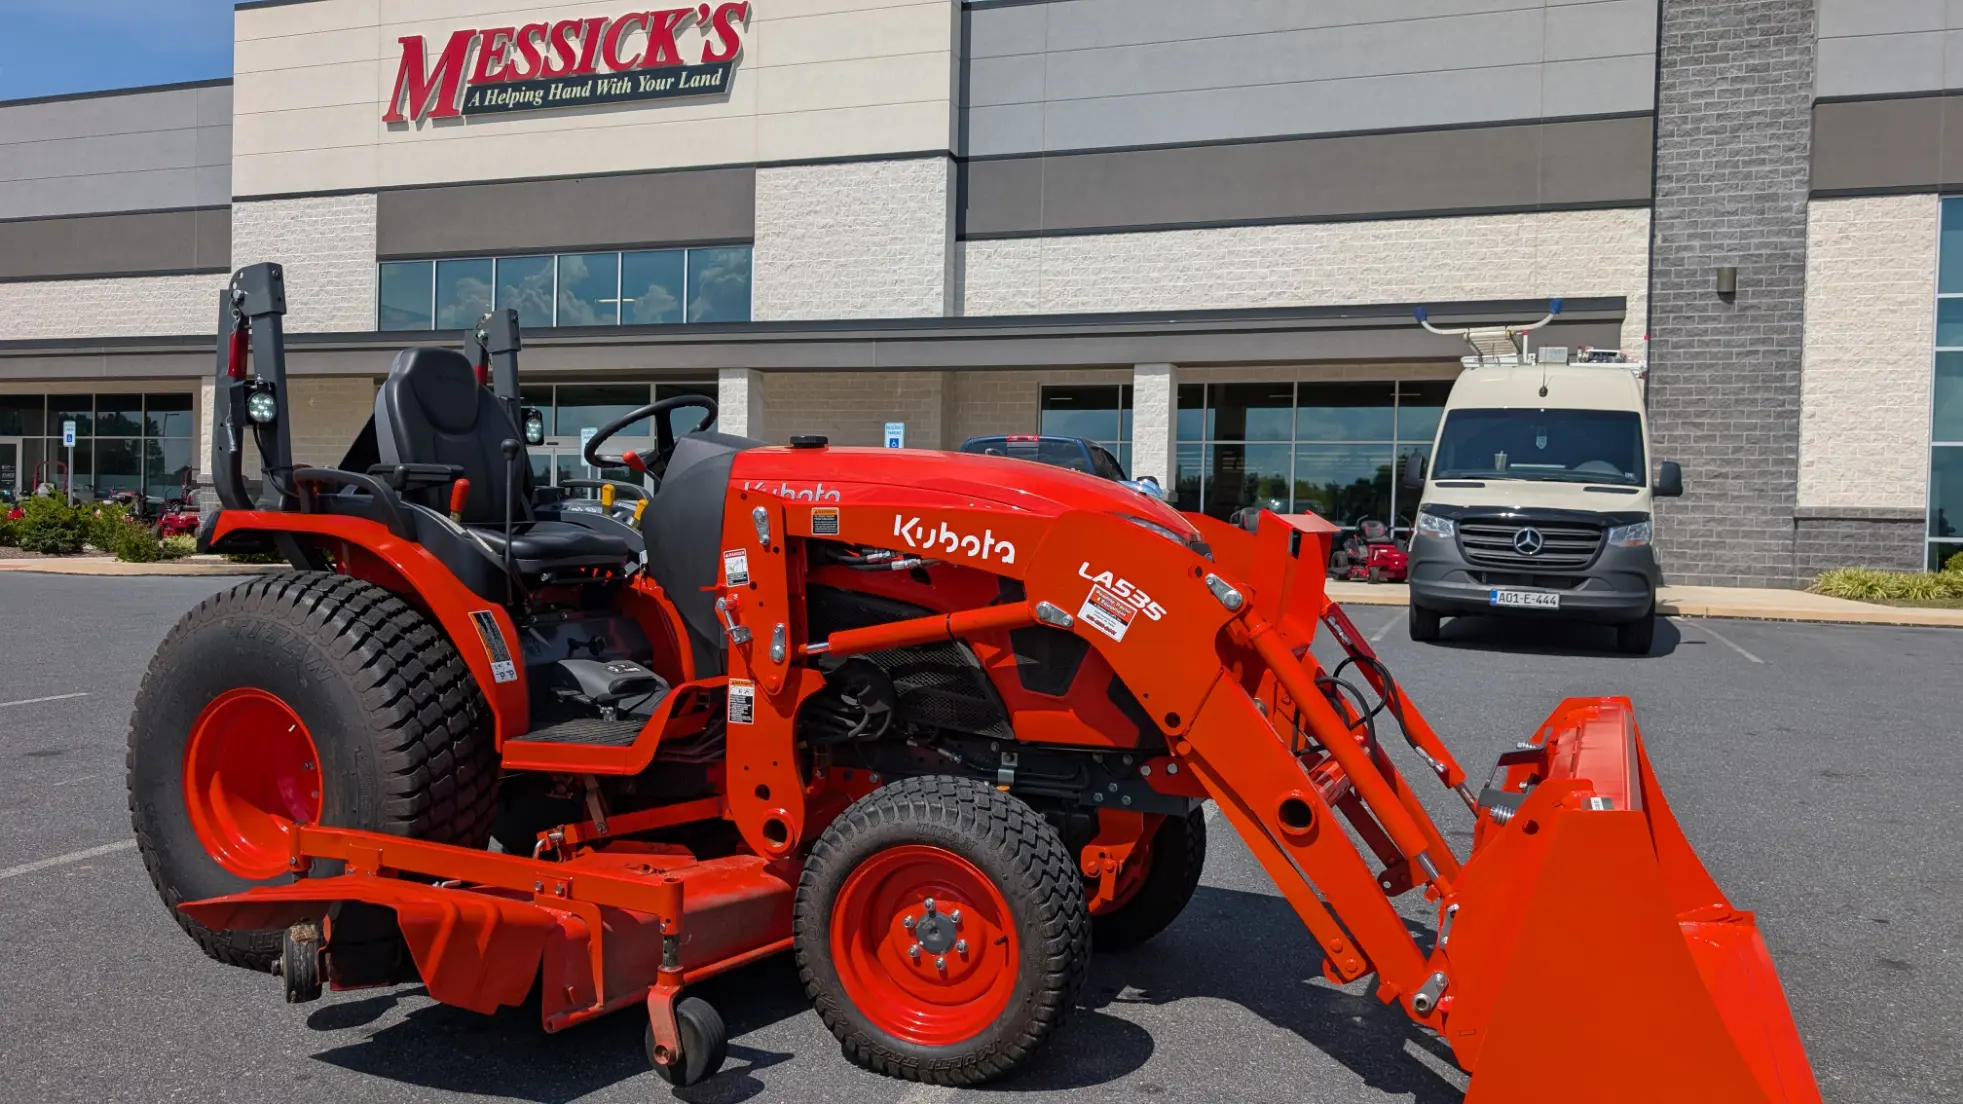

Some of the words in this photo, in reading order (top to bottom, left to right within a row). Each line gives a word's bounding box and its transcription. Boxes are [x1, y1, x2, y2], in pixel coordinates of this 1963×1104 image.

[468, 91, 481, 107] A
[483, 86, 544, 108] Helping
[548, 80, 593, 101] Hand
[596, 77, 632, 96] With
[638, 74, 675, 93] Your
[678, 68, 723, 89] Land
[893, 514, 1016, 565] Kubota
[1078, 561, 1168, 622] LA535
[1498, 592, 1557, 606] A01-E-444
